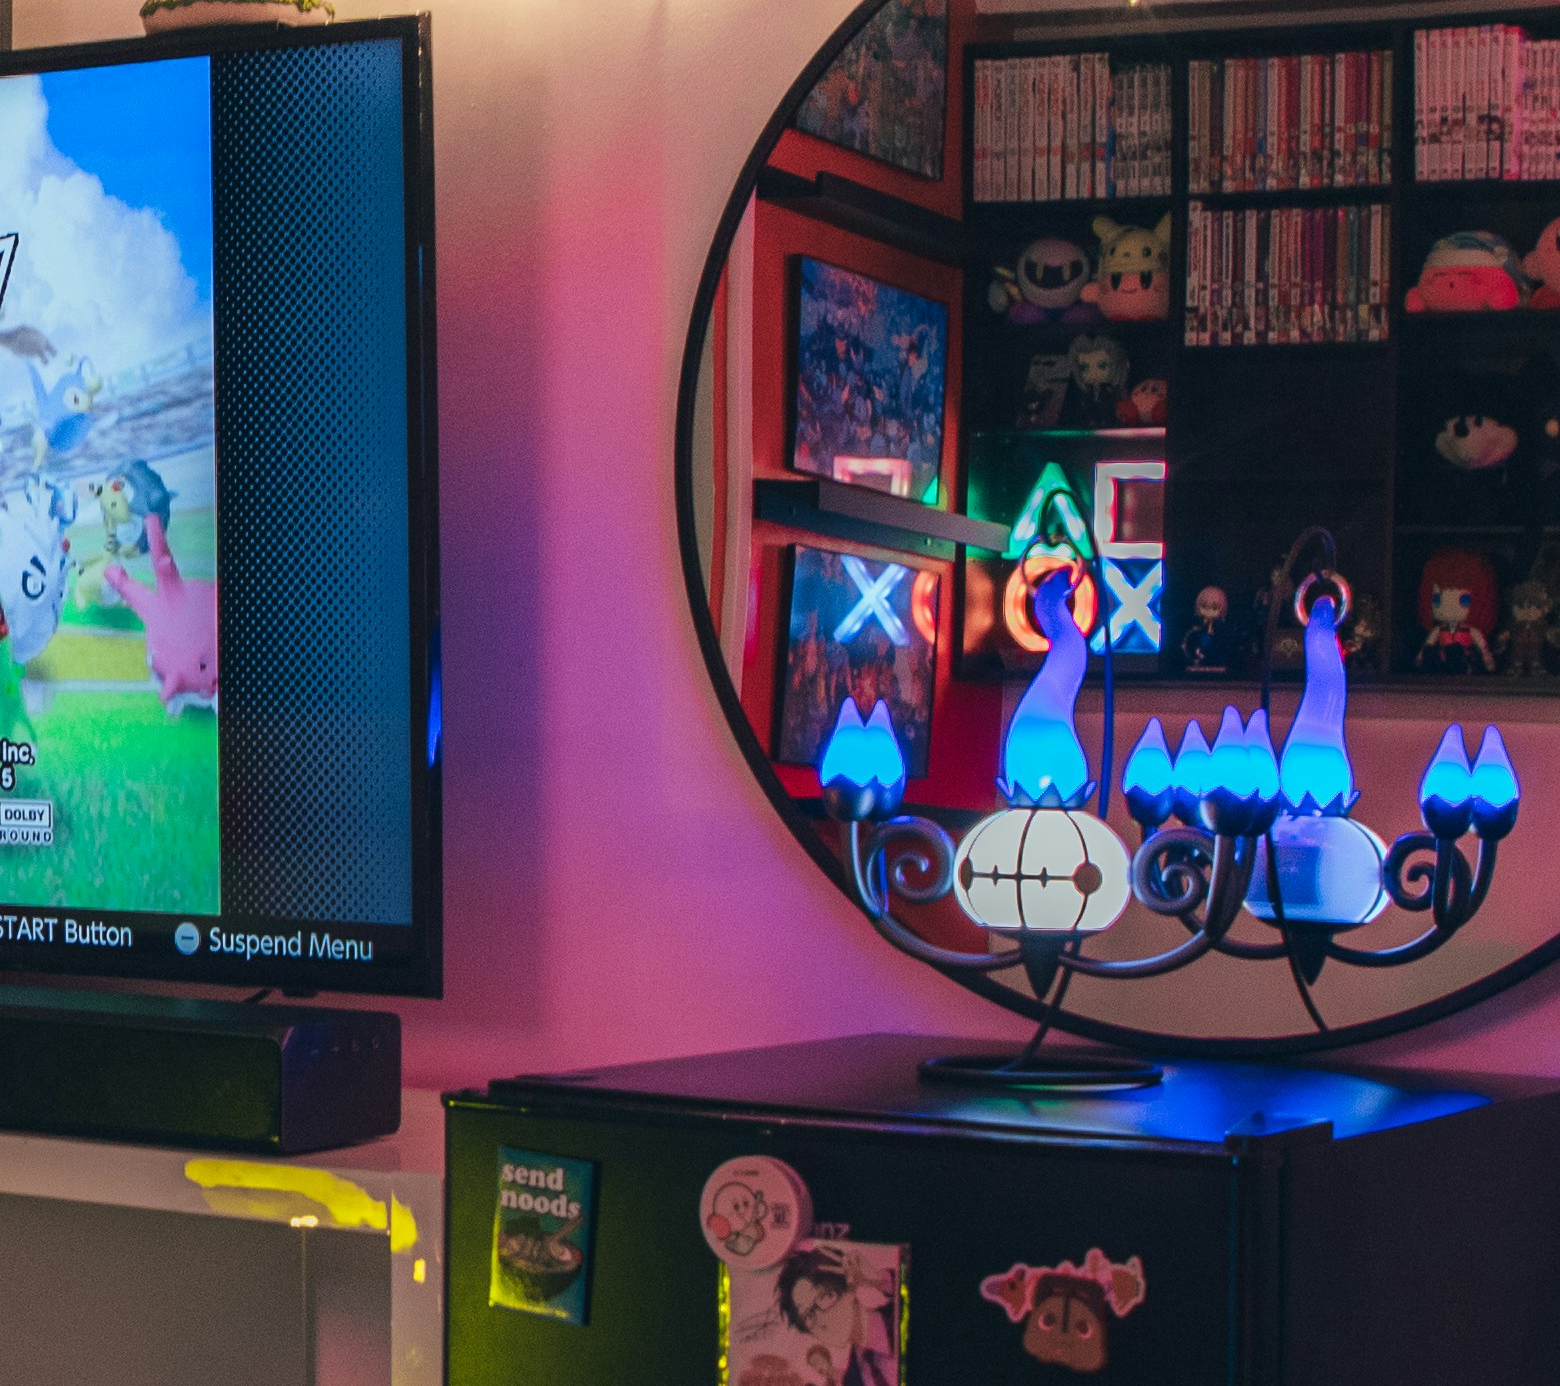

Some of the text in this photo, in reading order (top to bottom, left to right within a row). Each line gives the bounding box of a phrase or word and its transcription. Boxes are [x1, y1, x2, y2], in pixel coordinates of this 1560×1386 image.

[0, 768, 14, 788] 5
[4, 805, 45, 821] DOLBY
[66, 919, 132, 948] Button
[209, 929, 373, 961] Suspend Menu
[501, 1163, 564, 1191] send
[500, 1189, 582, 1220] noods
